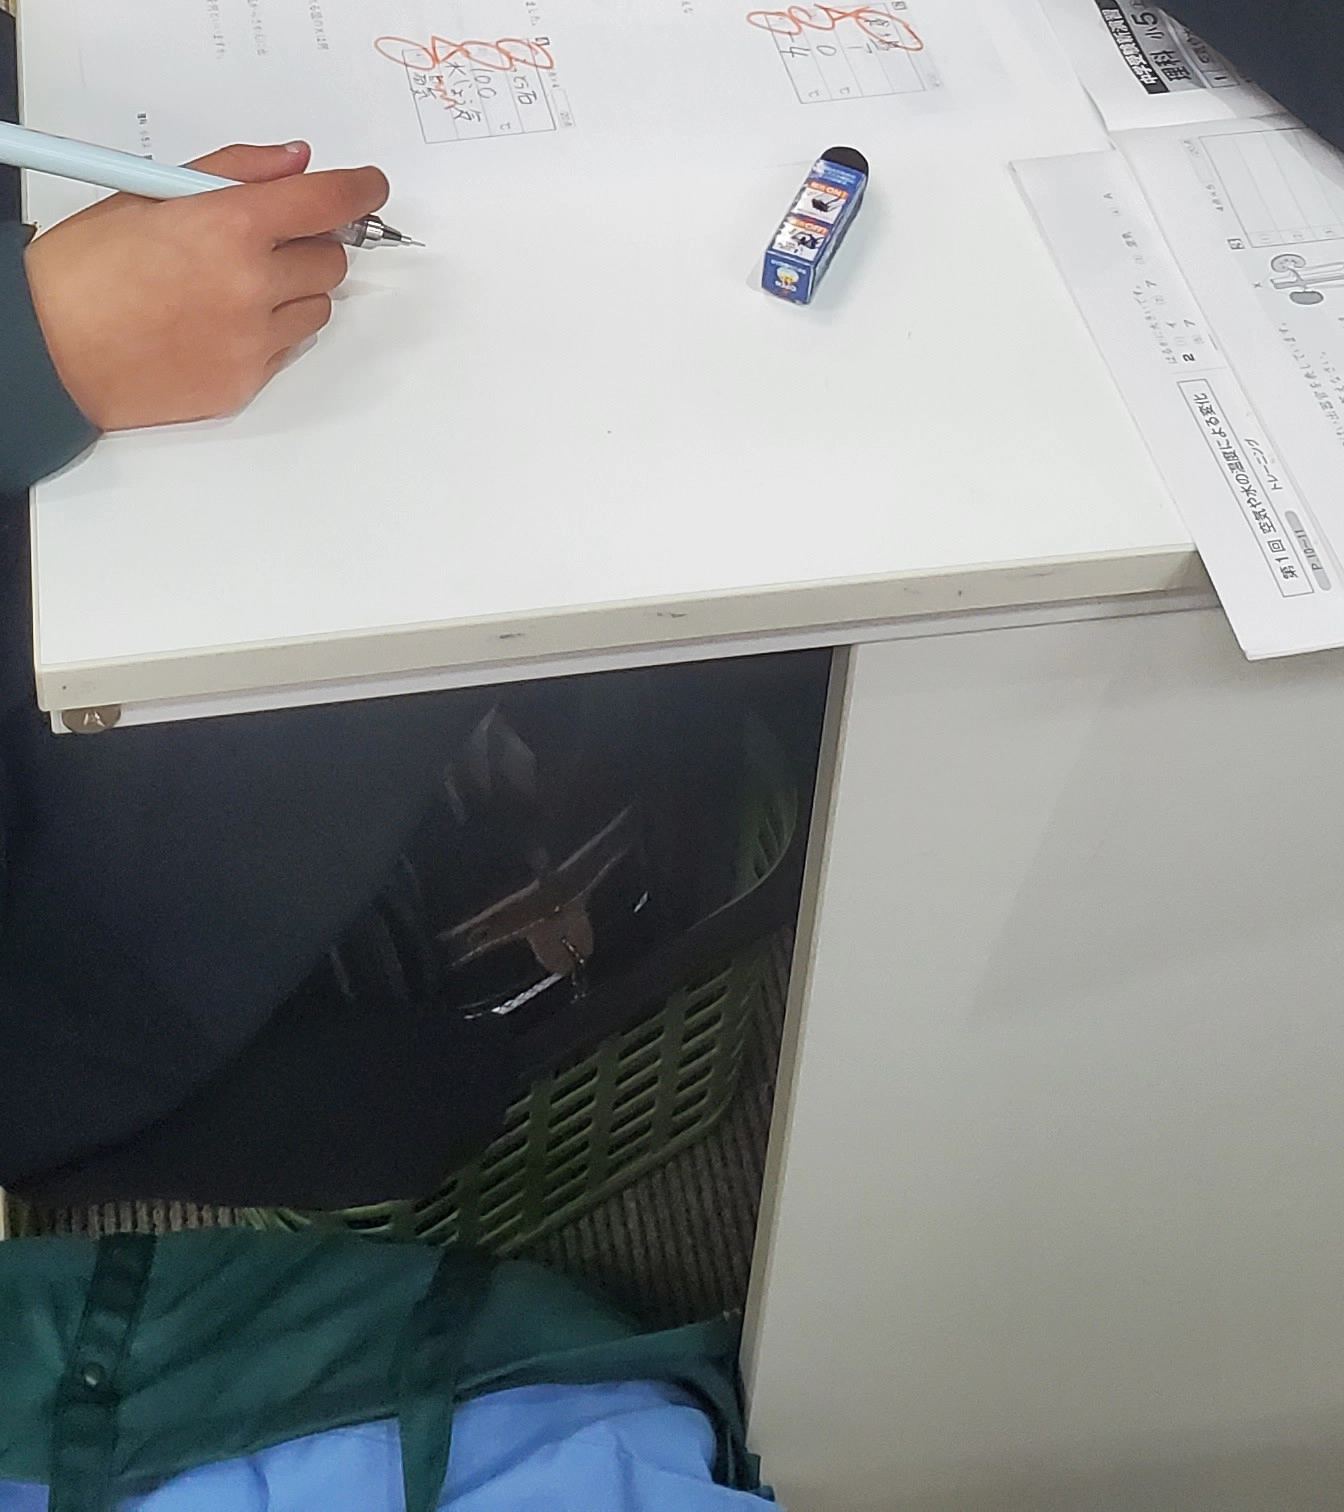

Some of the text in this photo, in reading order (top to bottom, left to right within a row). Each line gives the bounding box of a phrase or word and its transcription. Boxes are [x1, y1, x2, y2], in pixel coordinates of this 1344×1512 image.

[1149, 50, 1190, 81] 理科
[469, 67, 501, 99] 100
[1181, 351, 1196, 364] 2
[1243, 435, 1283, 492] トレーニング
[1191, 390, 1298, 580] 第1回 空気や水の温度による変化
